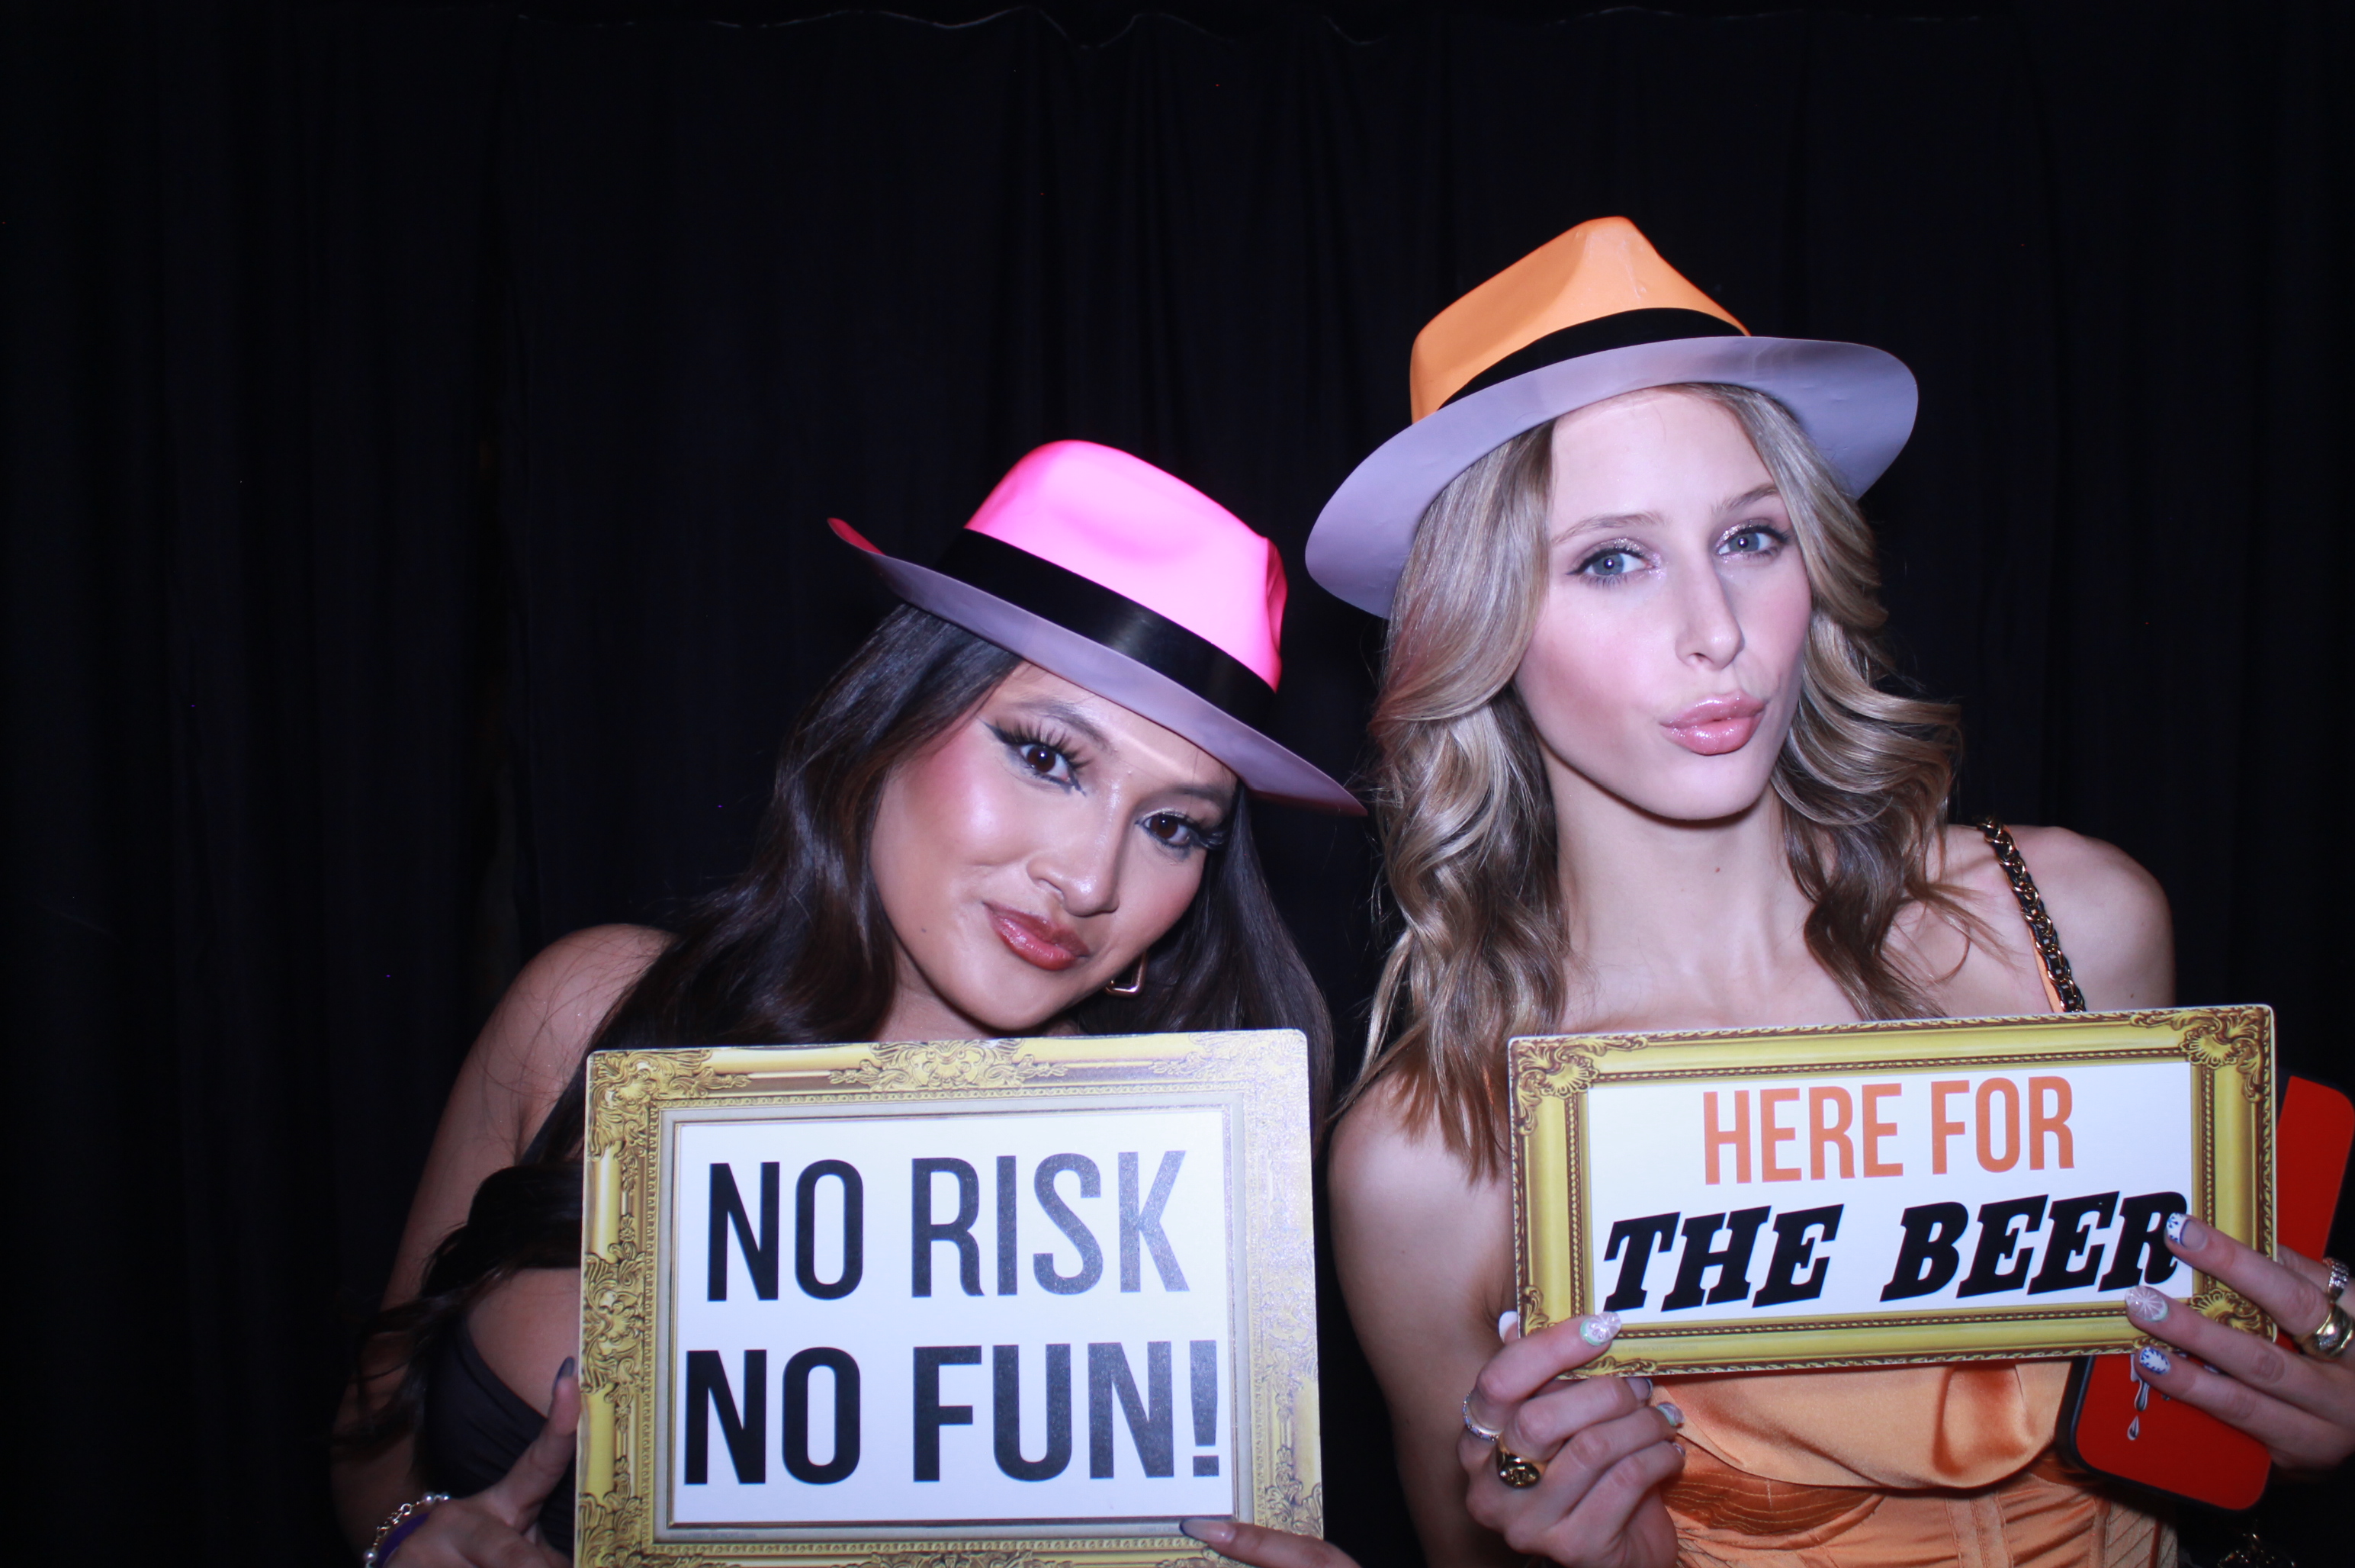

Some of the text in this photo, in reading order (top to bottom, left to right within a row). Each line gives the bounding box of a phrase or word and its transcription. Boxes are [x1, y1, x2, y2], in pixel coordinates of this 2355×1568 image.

[1703, 1075, 2076, 1186] HERE FOR
[707, 1150, 1190, 1303] NO RISK
[1603, 1190, 2187, 1313] THE BEER
[683, 1339, 1220, 1487] NO FUN!
